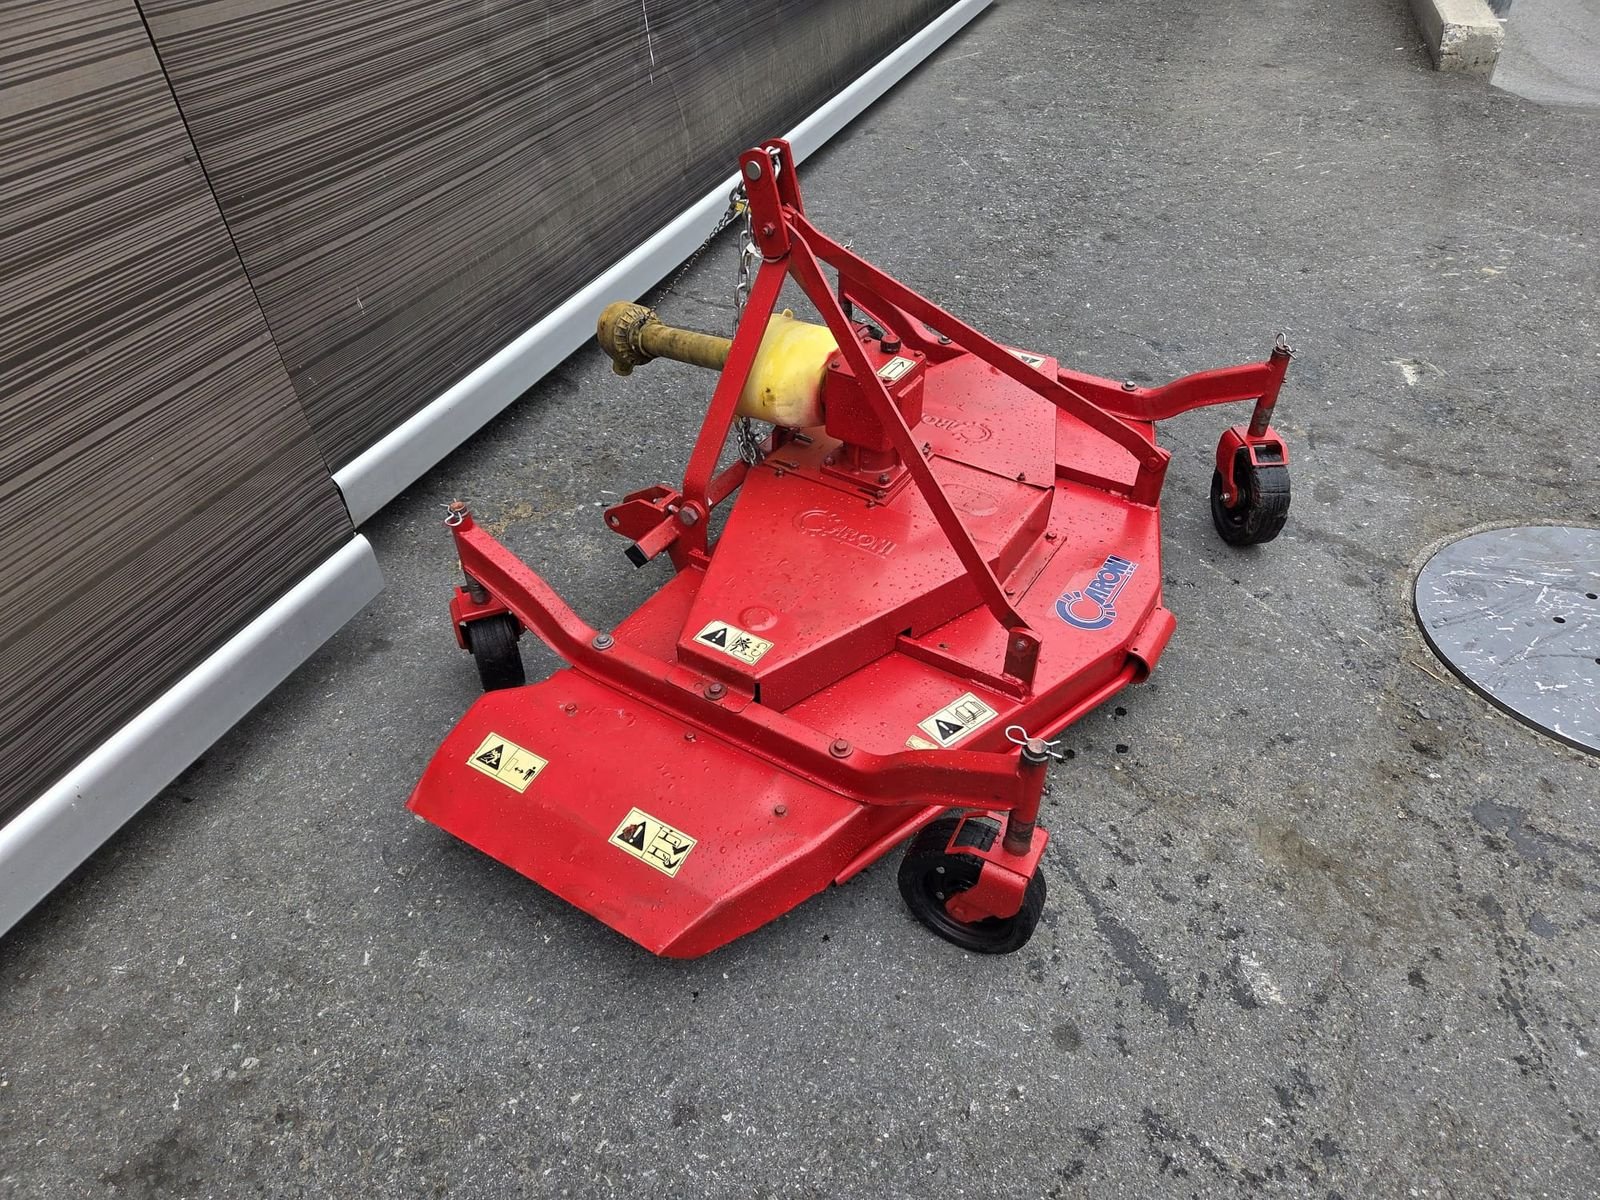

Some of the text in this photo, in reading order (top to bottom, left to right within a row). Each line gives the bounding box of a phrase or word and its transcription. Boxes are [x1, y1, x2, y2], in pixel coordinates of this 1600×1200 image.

[920, 412, 992, 445] CARO
[792, 509, 897, 556] CARONI
[1055, 554, 1133, 630] CARONI
